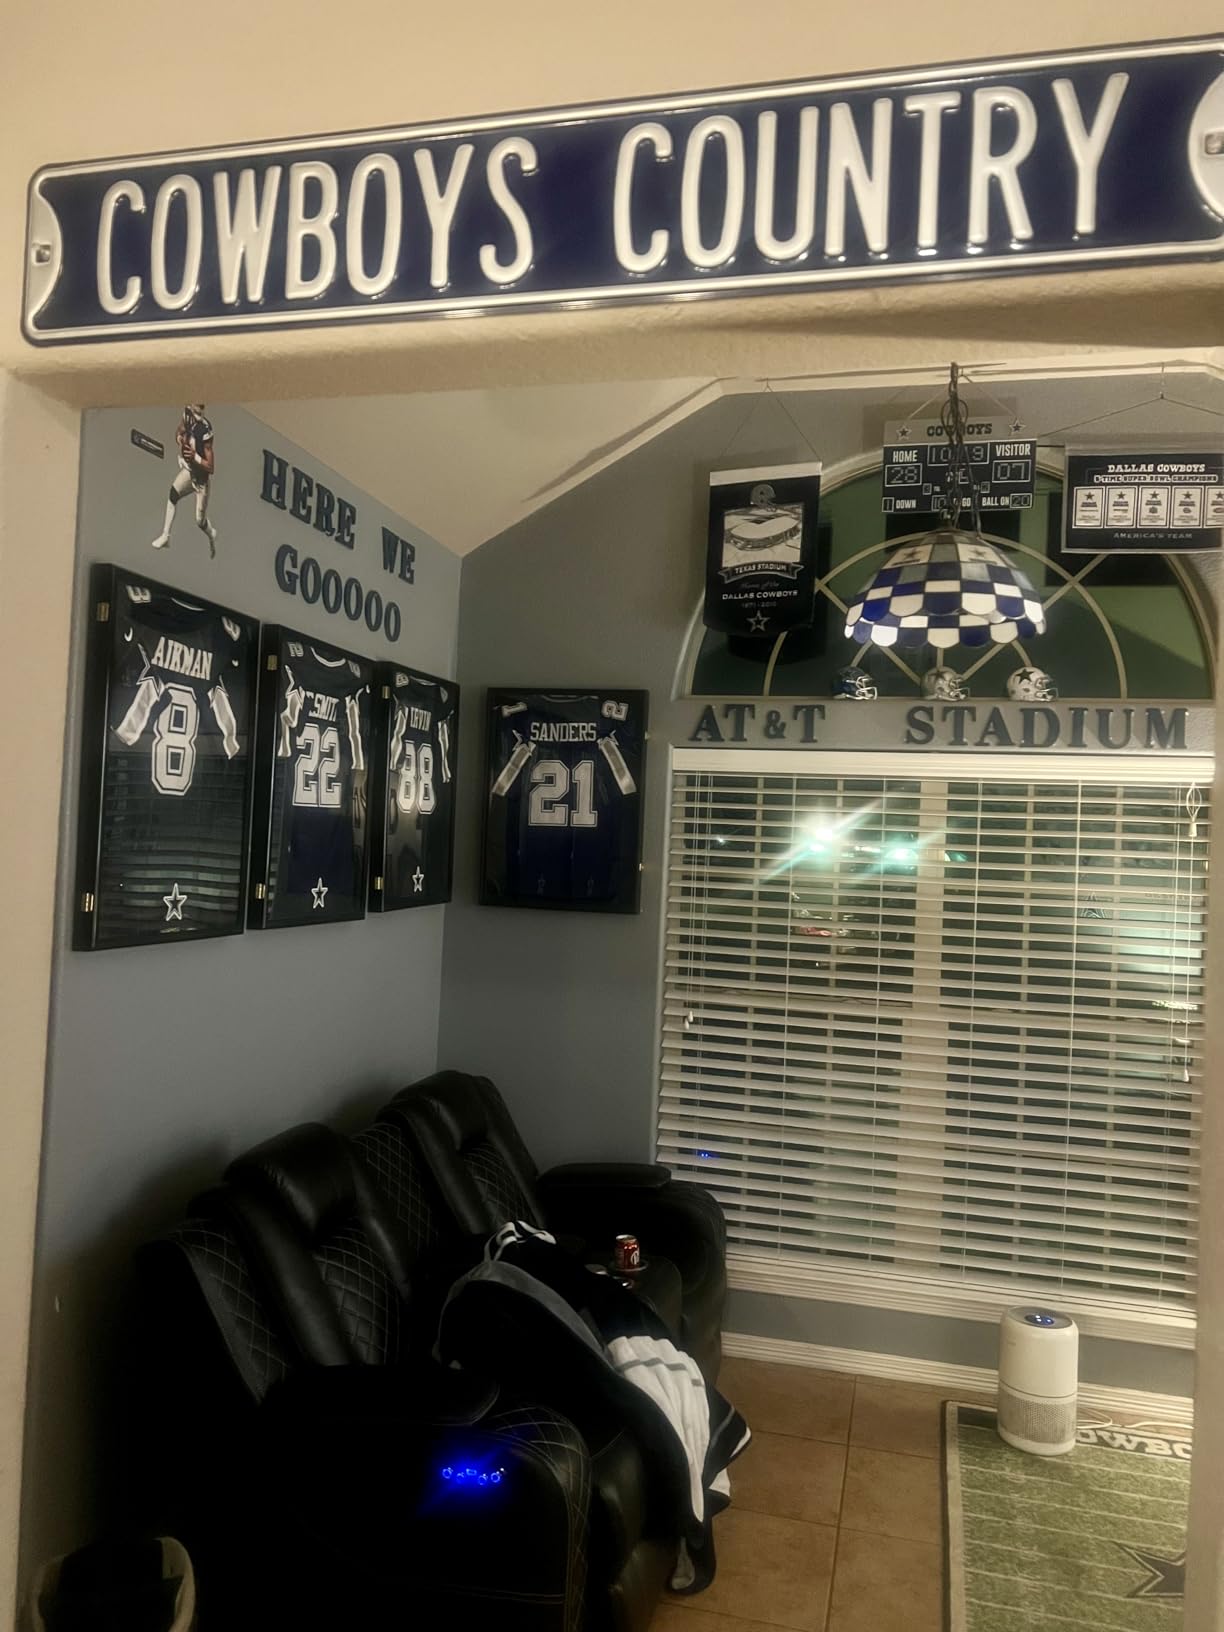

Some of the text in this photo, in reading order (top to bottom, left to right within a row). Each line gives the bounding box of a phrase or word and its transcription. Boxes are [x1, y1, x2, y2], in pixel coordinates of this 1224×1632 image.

[95, 72, 1131, 316] COWBOYS COUNTRY
[926, 423, 993, 437] COOYS
[892, 450, 918, 463] HOME
[995, 444, 1031, 457] VISITOR
[891, 466, 918, 484] 28
[1107, 463, 1206, 473] DALLAS COWBOYS
[896, 499, 916, 509] DOWN
[982, 496, 999, 506] BALL
[1000, 495, 1010, 506] ON
[260, 448, 416, 585] HERE WE
[735, 563, 787, 574] TEXAS STADIUM
[274, 543, 402, 643] GOOOOO
[722, 590, 798, 600] DALLAS COWBOYS
[151, 636, 214, 681] AIKMAN
[530, 722, 598, 742] SANDERS
[689, 703, 1191, 750] AT&T STADIUM
[151, 682, 200, 796] 8
[292, 722, 342, 808] 22
[398, 739, 437, 815] 88
[528, 759, 598, 828] 21
